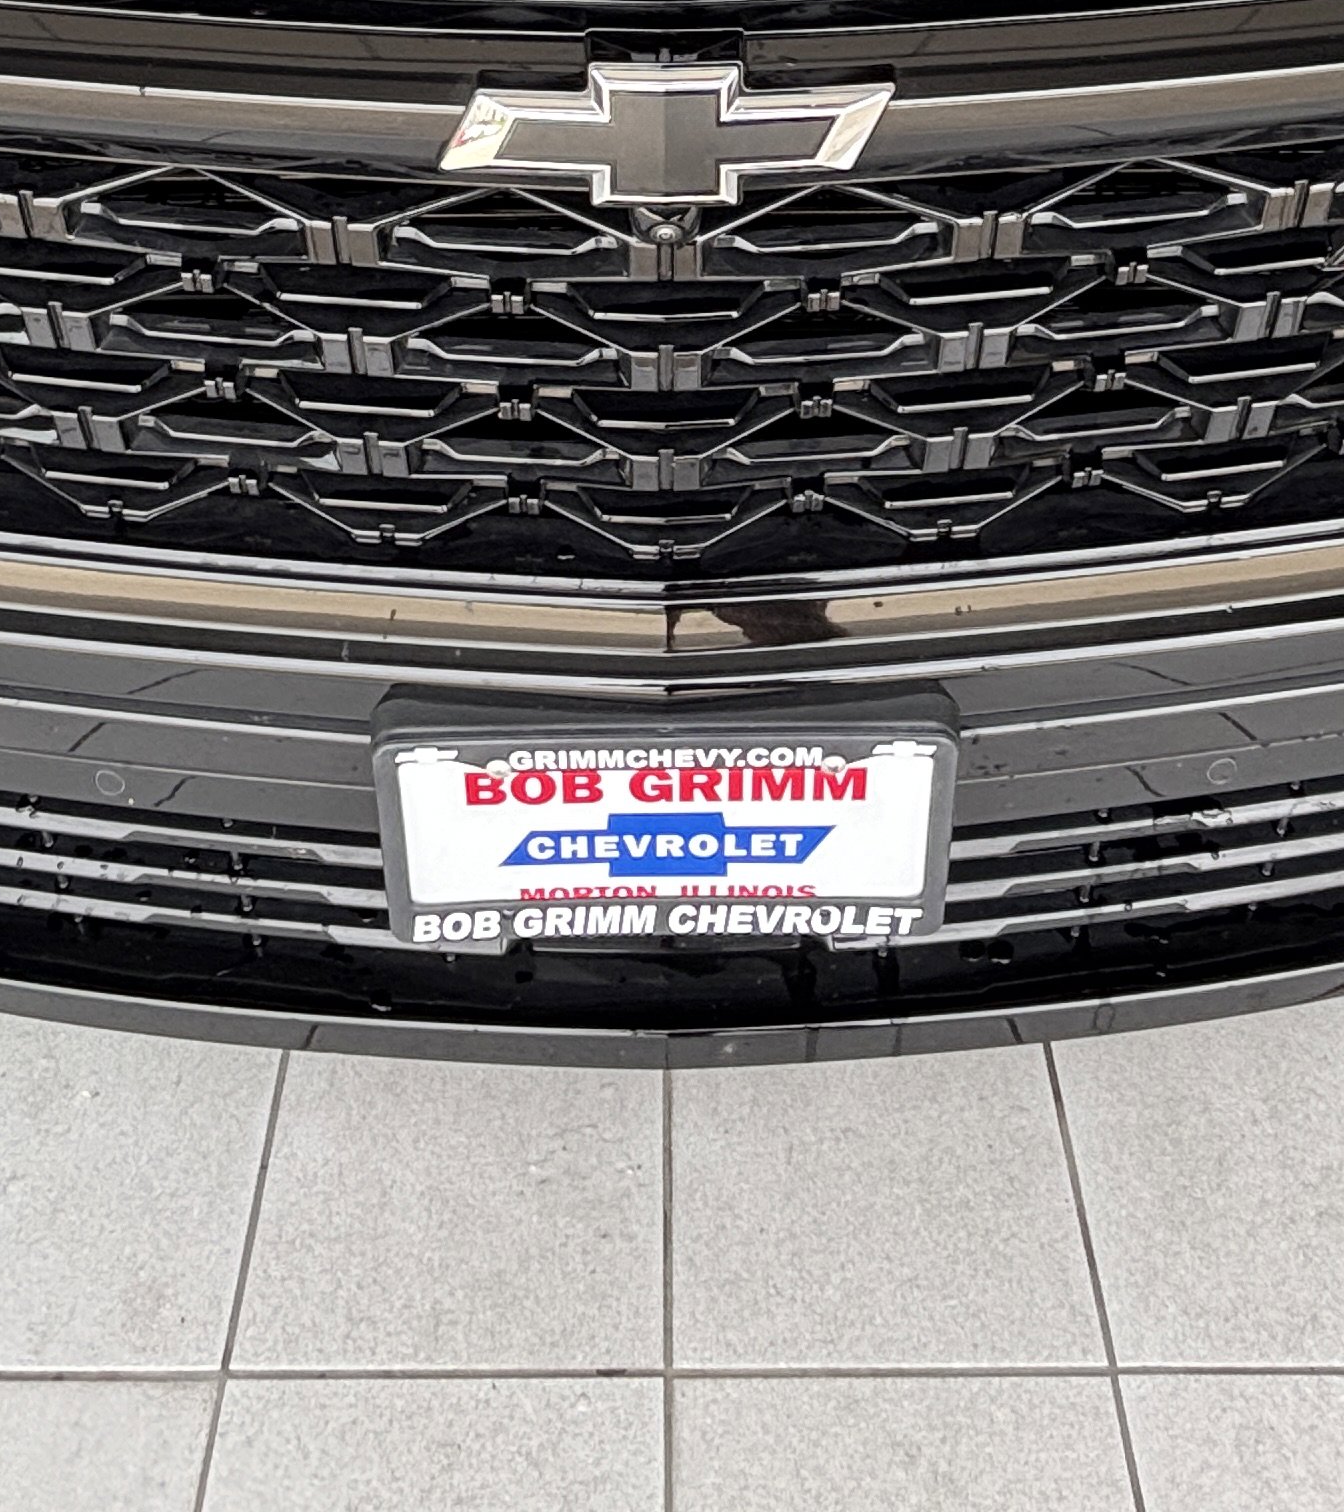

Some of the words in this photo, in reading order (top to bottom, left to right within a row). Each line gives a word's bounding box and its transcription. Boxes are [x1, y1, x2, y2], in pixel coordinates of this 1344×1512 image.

[509, 746, 824, 771] GRIMMCHEVY.COM
[464, 769, 604, 806] BOB
[628, 766, 868, 803] GRIMM
[526, 832, 805, 859] CHEVROLET
[413, 909, 502, 942] BOB
[513, 904, 657, 937] GRIMM
[668, 904, 923, 935] CHEVROLET
